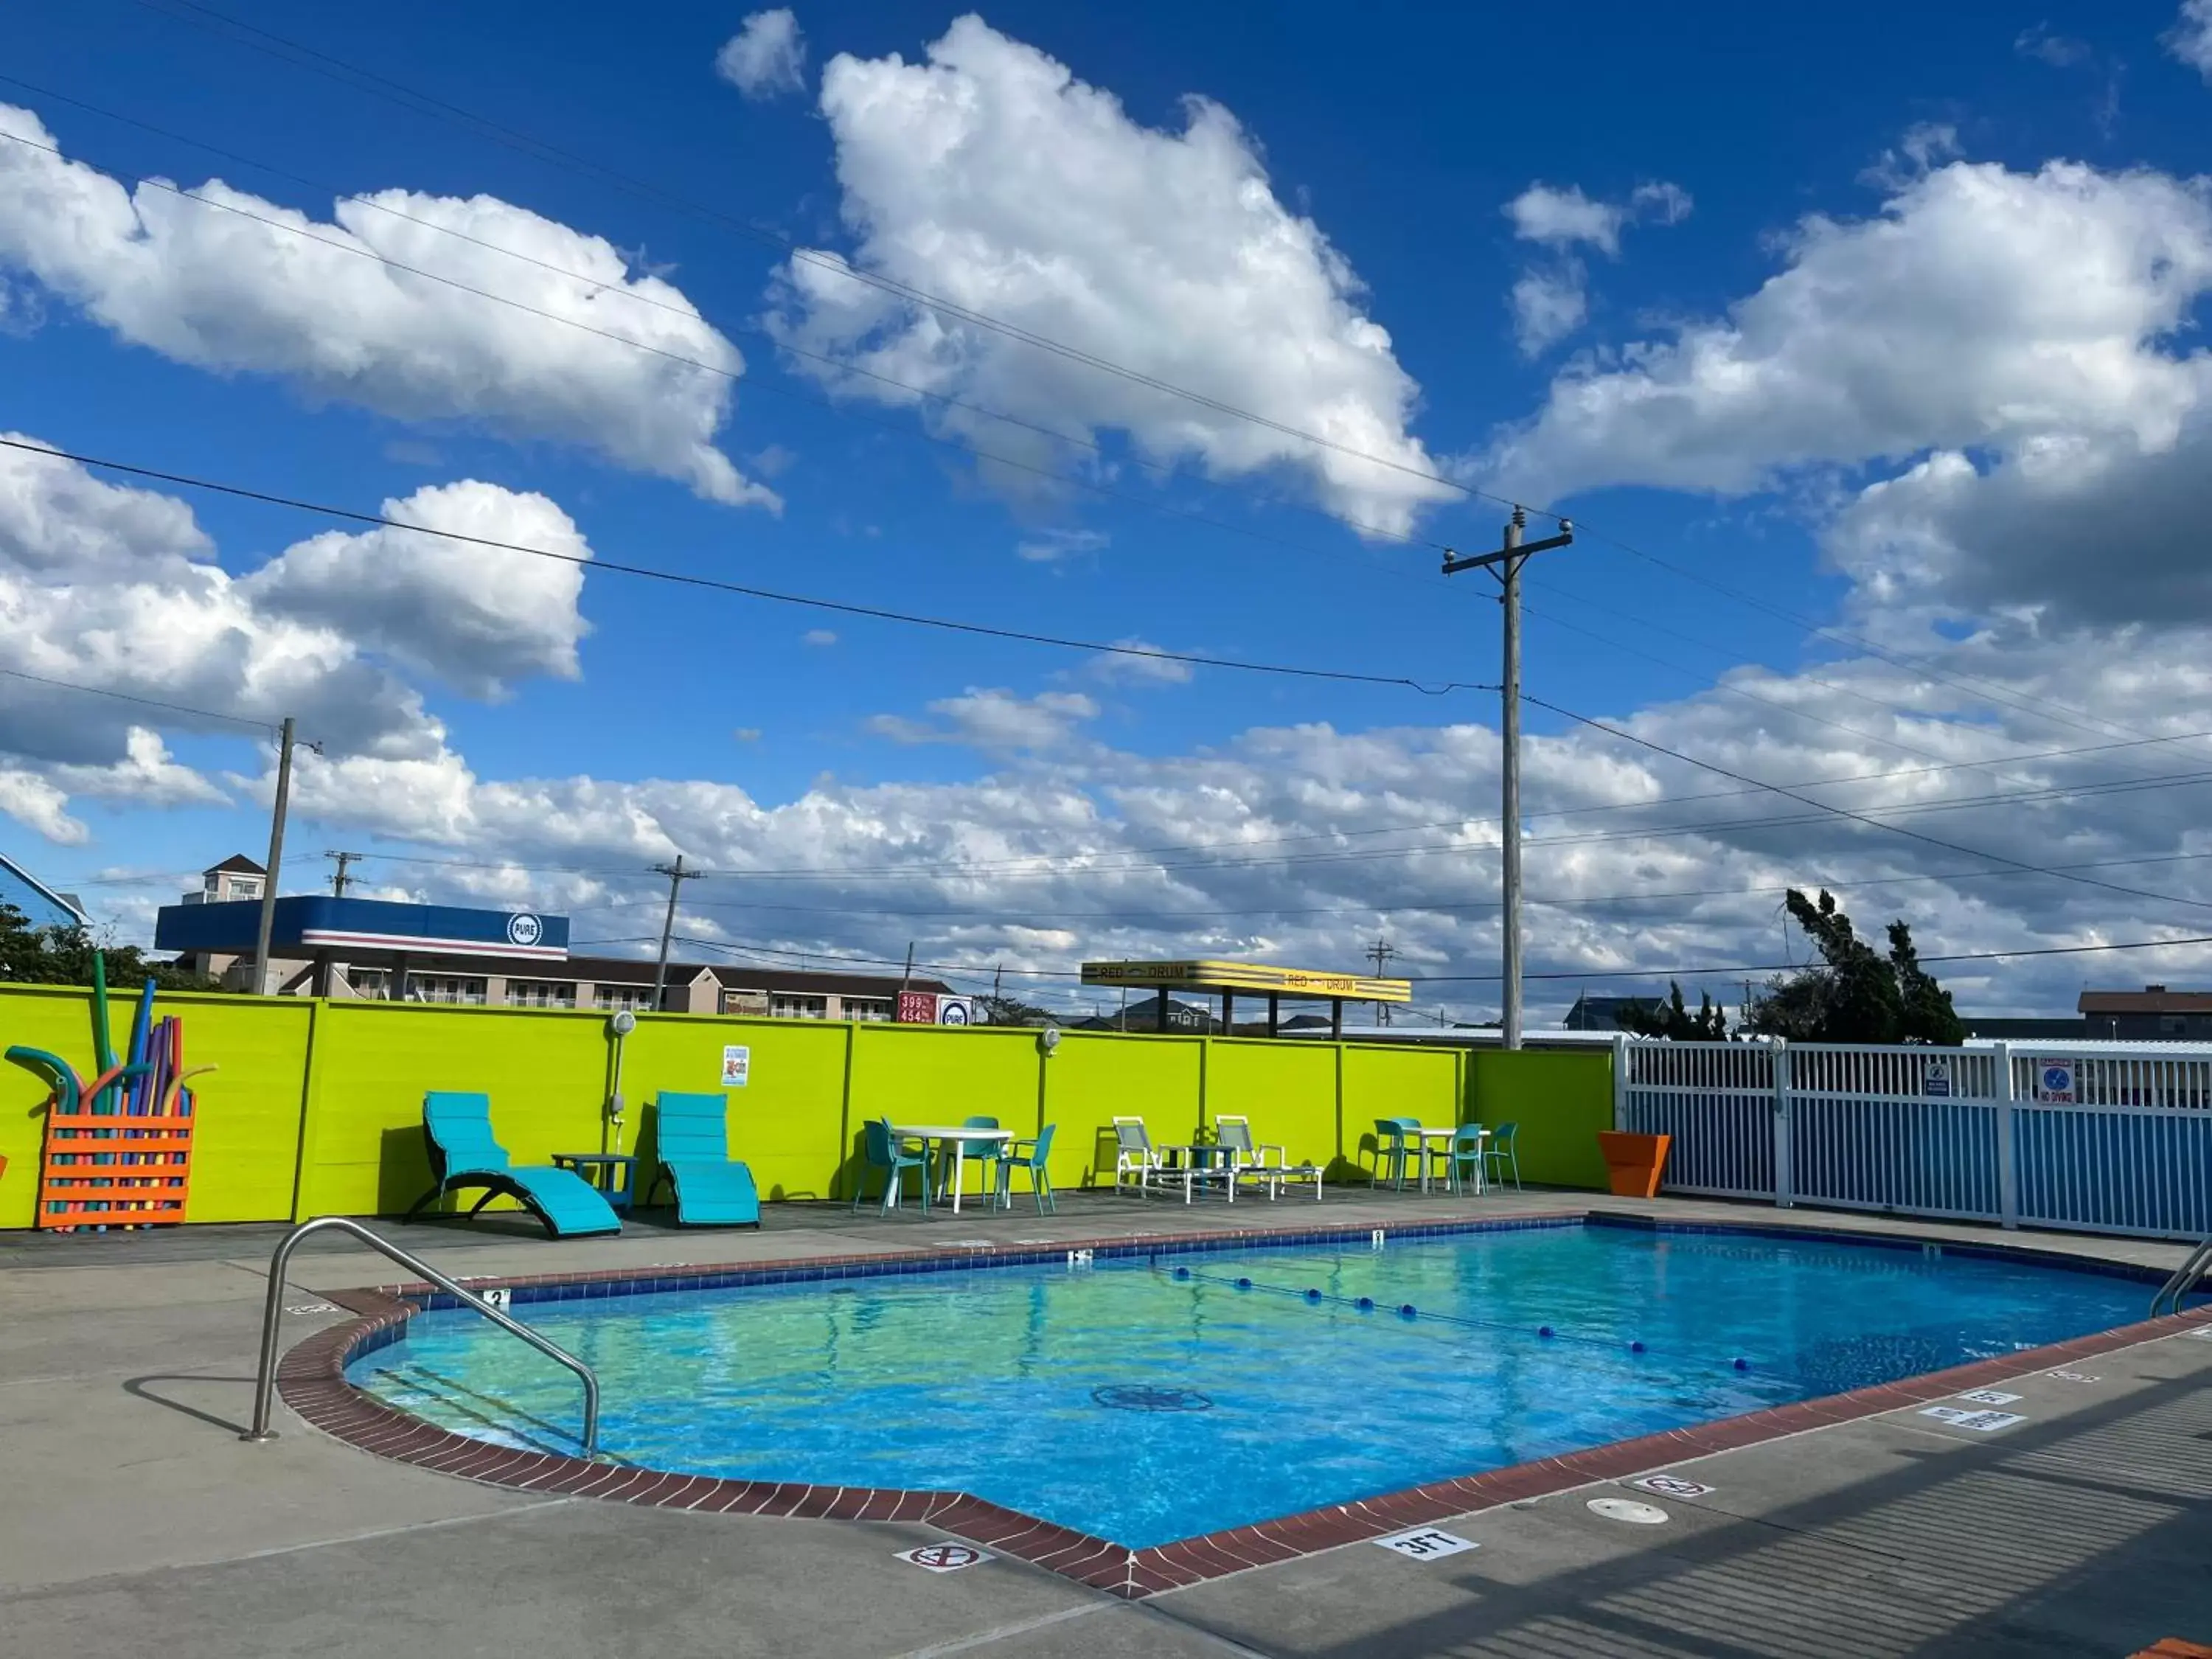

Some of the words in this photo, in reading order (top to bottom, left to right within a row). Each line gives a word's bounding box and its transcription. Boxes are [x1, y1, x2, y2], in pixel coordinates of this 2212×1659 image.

[516, 923, 535, 935] PURE
[1101, 967, 1123, 978] RED
[1149, 965, 1184, 978] DRUM
[1288, 974, 1307, 987] RED
[1326, 979, 1353, 991] DRUM
[1394, 1533, 1457, 1554] 3FT
